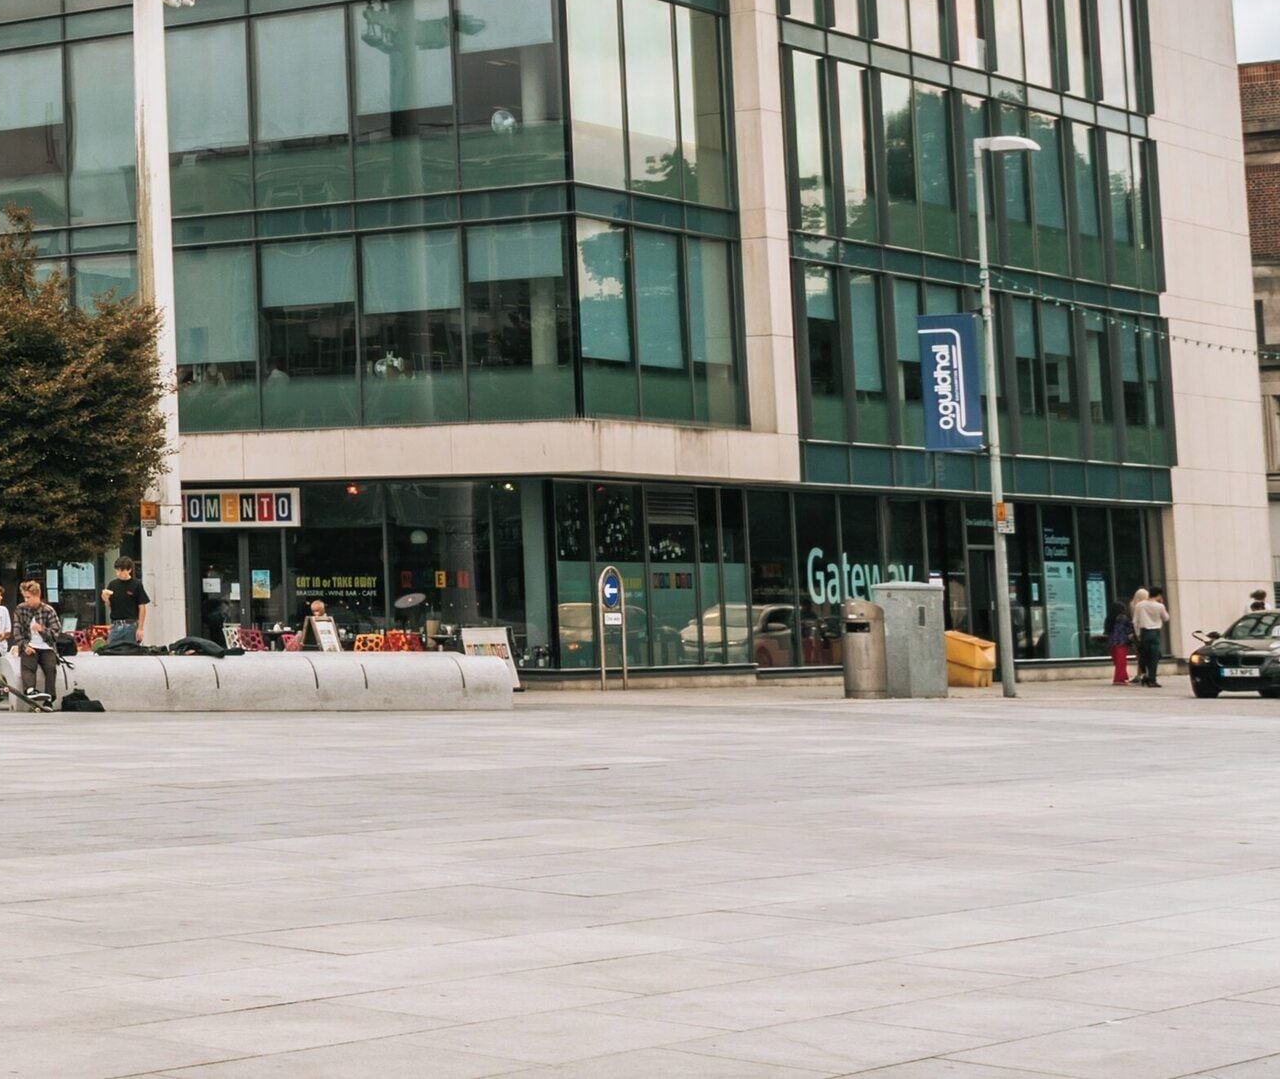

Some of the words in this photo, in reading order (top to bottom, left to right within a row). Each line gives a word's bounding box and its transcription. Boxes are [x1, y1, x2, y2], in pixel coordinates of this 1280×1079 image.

[183, 495, 289, 520] OMENTO
[296, 576, 310, 588] EAT
[311, 576, 321, 588] IN
[322, 579, 331, 588] or
[331, 576, 351, 588] TAKE
[353, 576, 377, 588] AWAY
